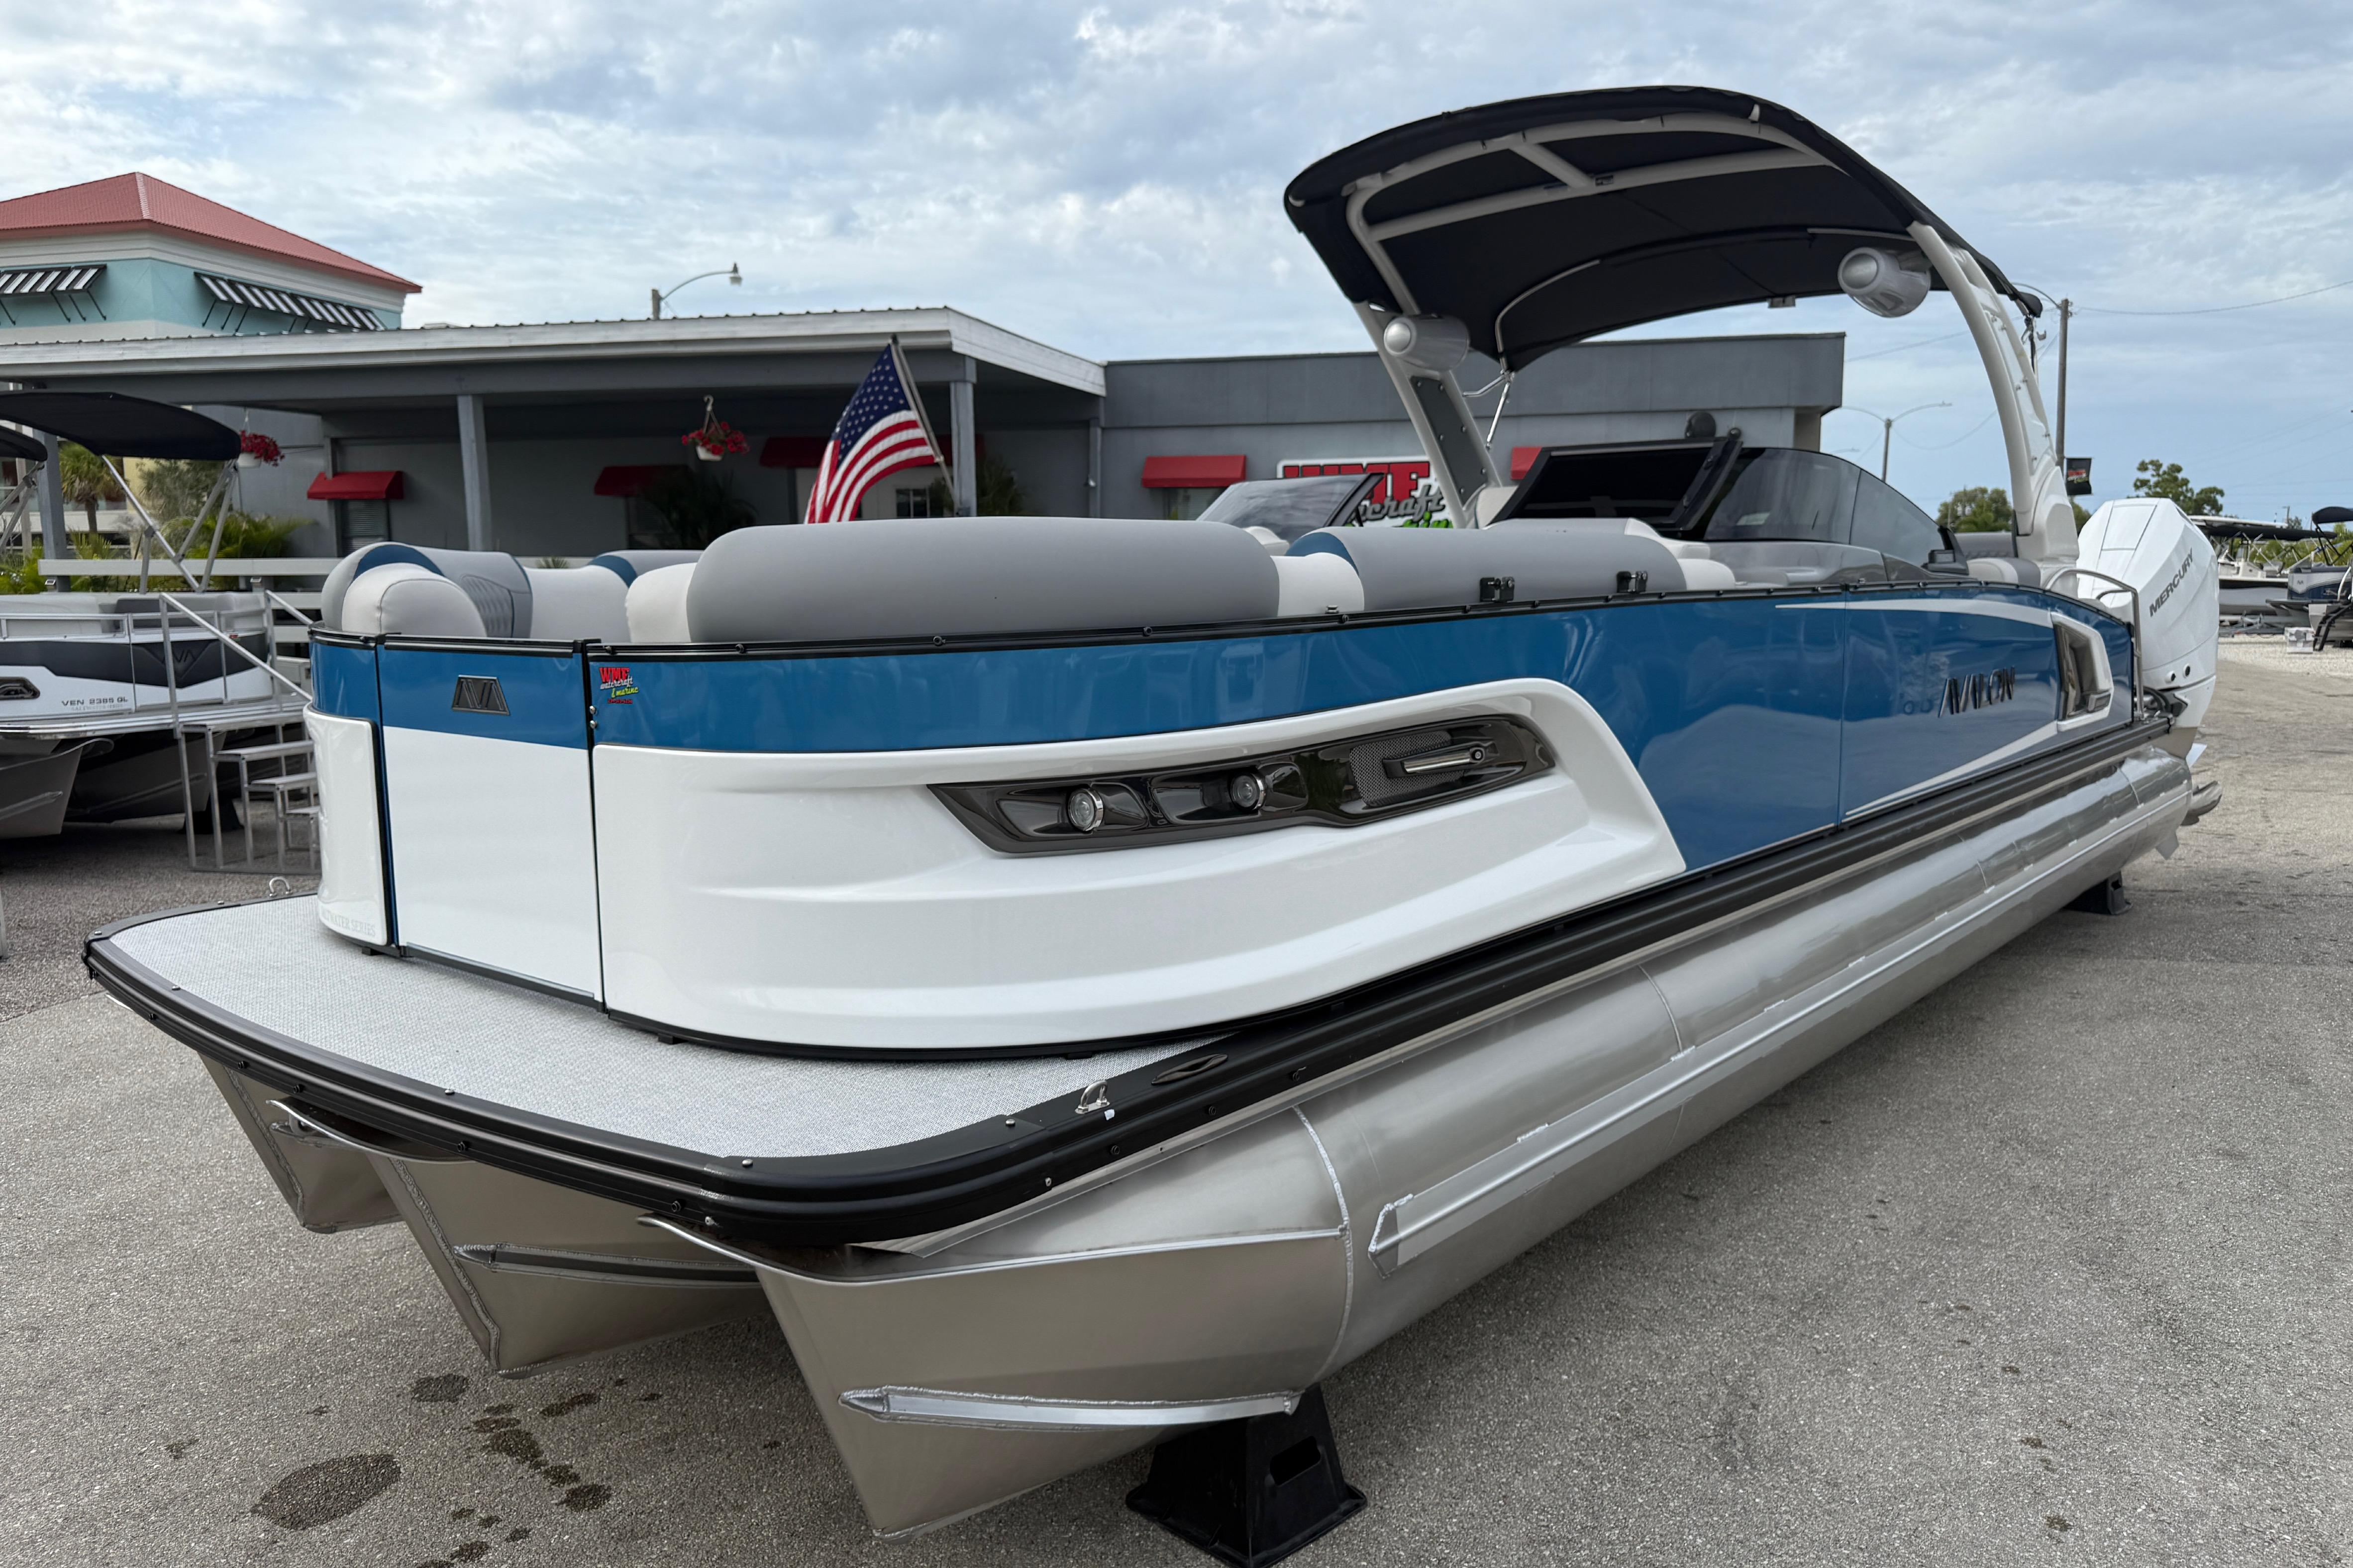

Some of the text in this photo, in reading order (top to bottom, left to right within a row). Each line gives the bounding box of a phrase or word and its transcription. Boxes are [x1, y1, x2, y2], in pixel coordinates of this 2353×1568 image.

[2149, 547, 2193, 617] MERCURY
[599, 667, 630, 683] WMF
[1938, 666, 2015, 718] AVALON
